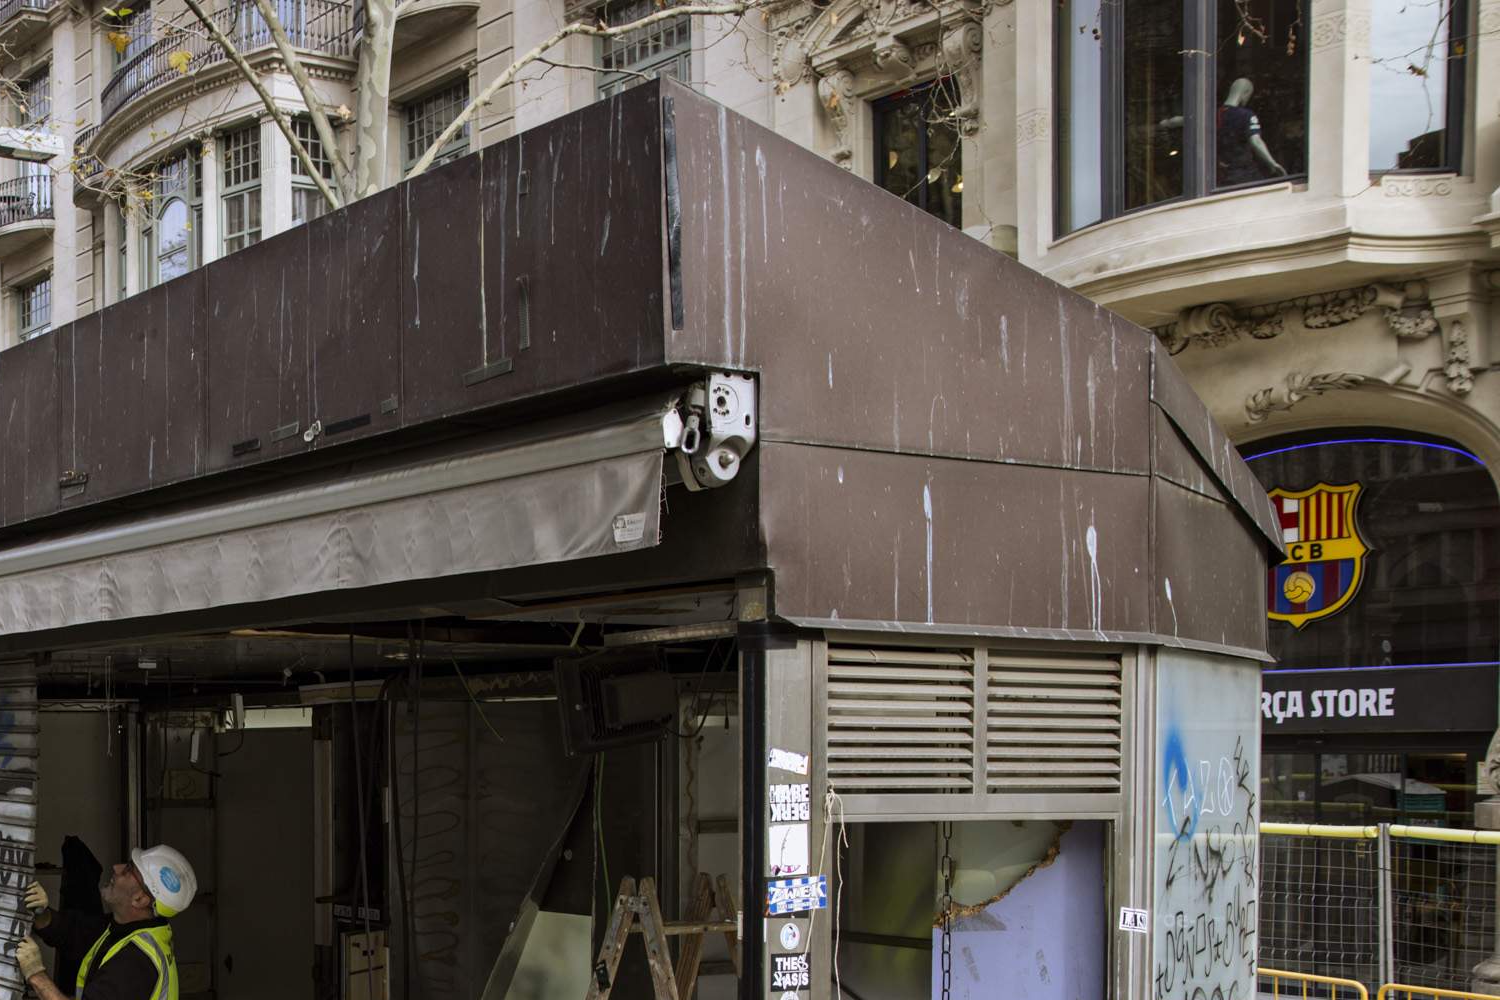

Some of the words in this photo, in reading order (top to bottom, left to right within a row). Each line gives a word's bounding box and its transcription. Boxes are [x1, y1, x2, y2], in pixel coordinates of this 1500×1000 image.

[1291, 543, 1323, 560] CB
[1261, 691, 1304, 723] RÇA
[1311, 687, 1395, 718] STORE
